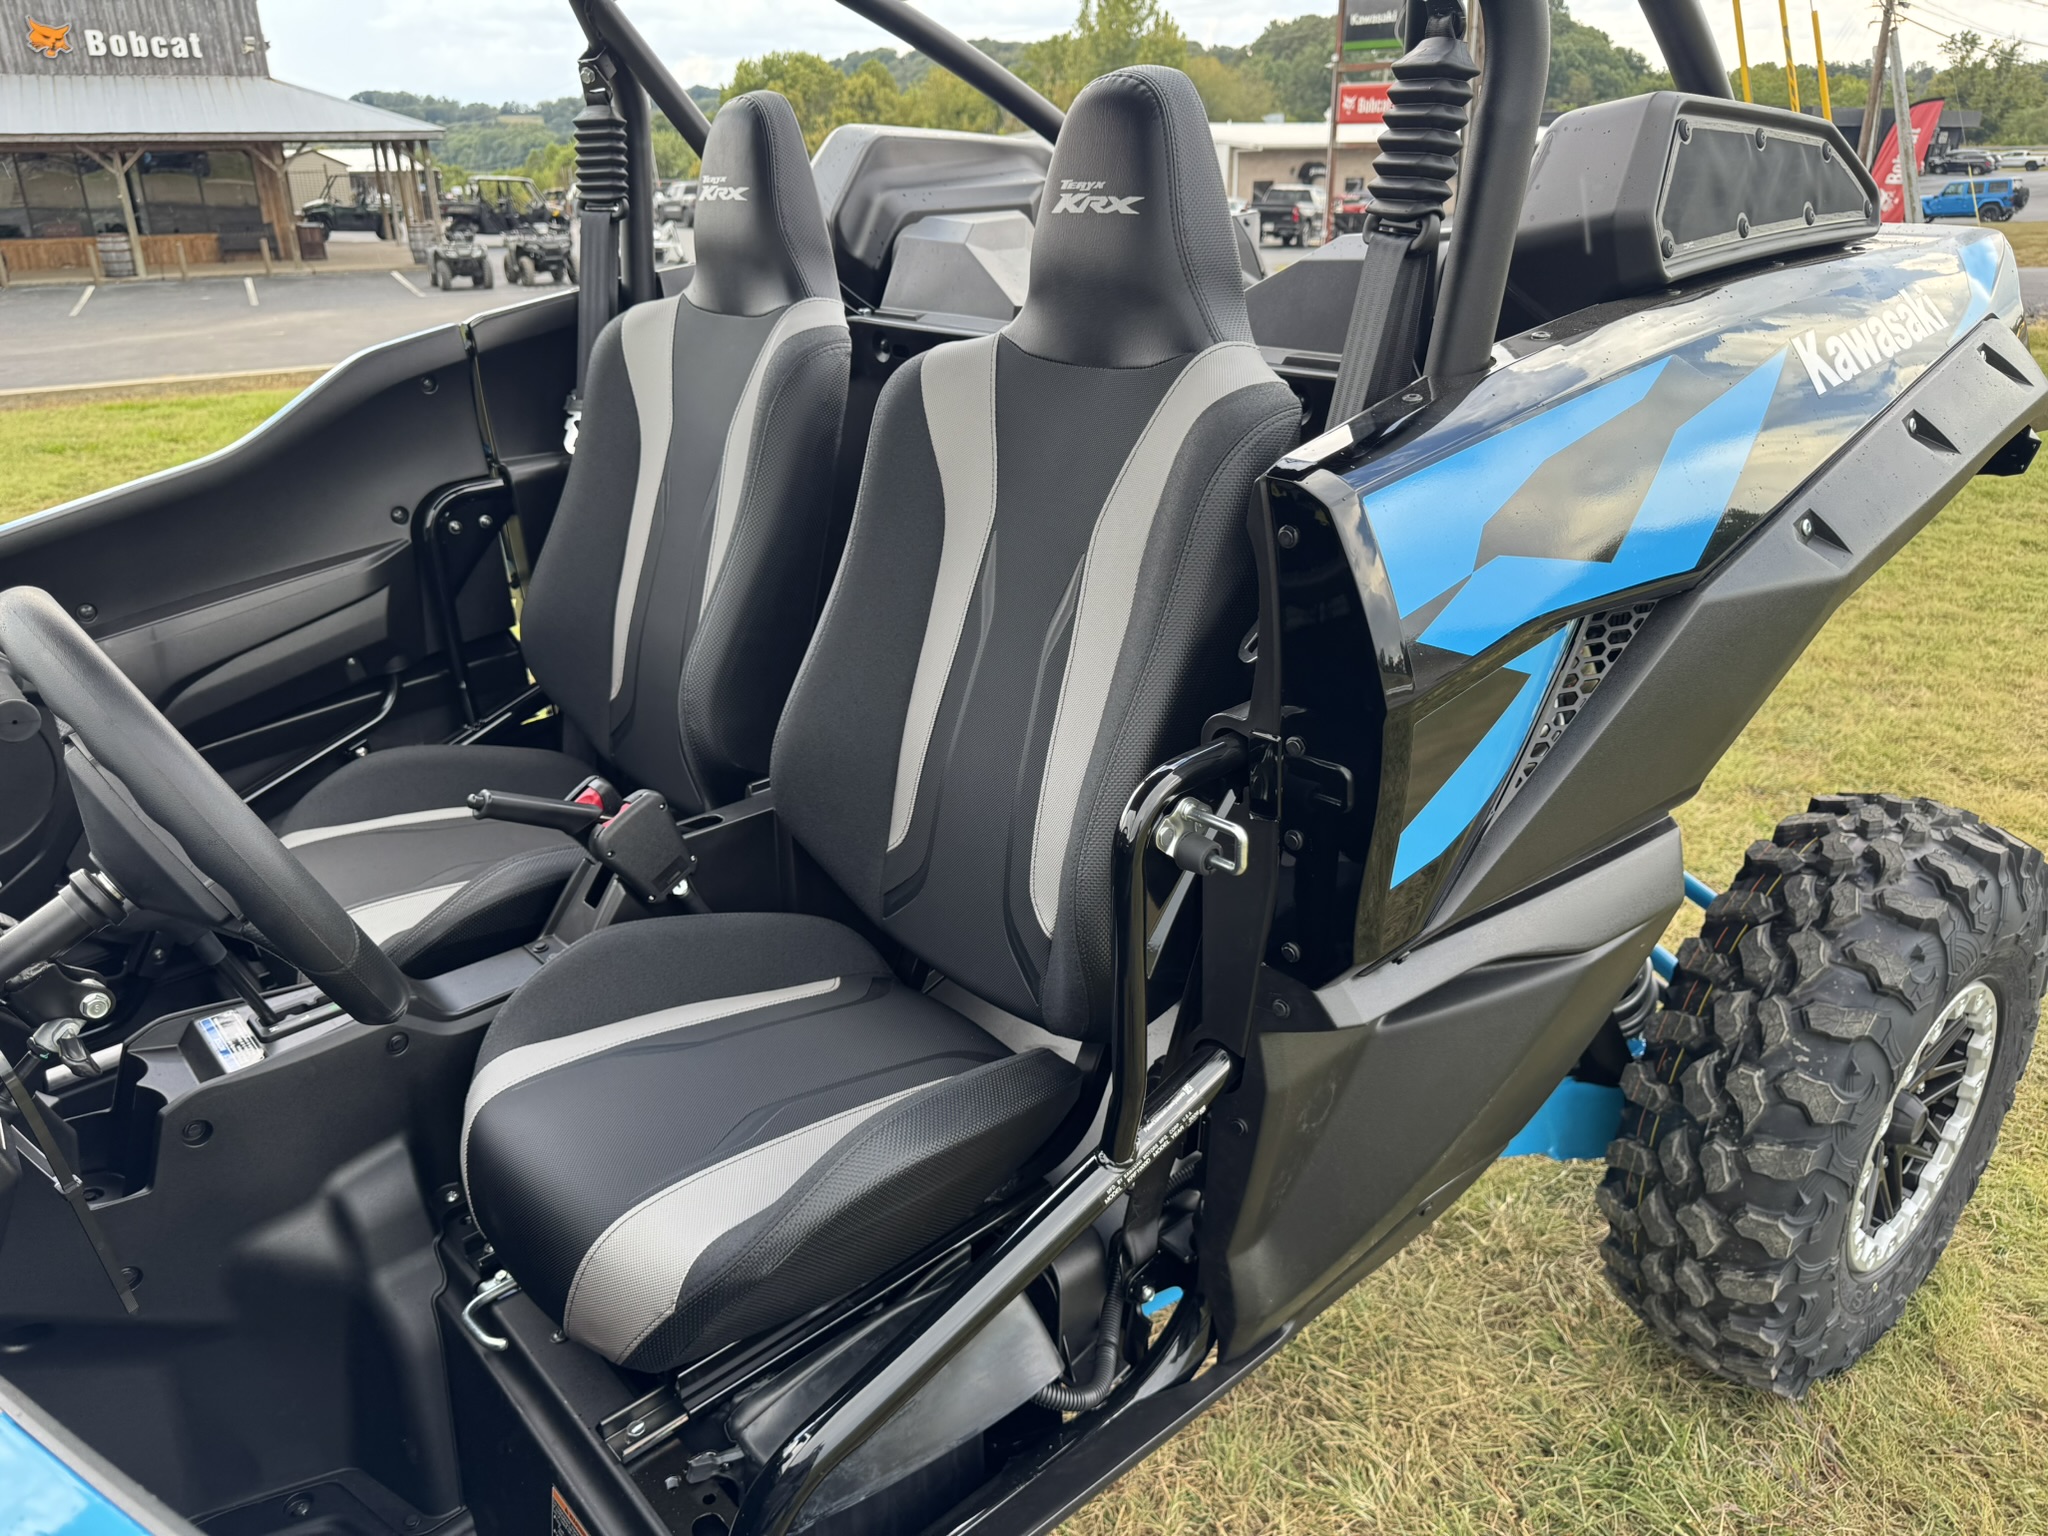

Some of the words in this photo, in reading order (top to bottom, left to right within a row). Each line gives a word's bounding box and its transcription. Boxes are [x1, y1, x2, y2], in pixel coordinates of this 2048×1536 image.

[1350, 9, 1398, 26] Kawasaki
[84, 29, 203, 59] Bobcat
[698, 185, 750, 202] KRX
[1051, 193, 1145, 215] KRX
[1790, 286, 1950, 397] Kawasaki
[1142, 1143, 1159, 1160] MOTORS
[1104, 1187, 1123, 1205] MODEL
[1153, 1141, 1170, 1158] MODEL
[1171, 1125, 1184, 1140] YEAR
